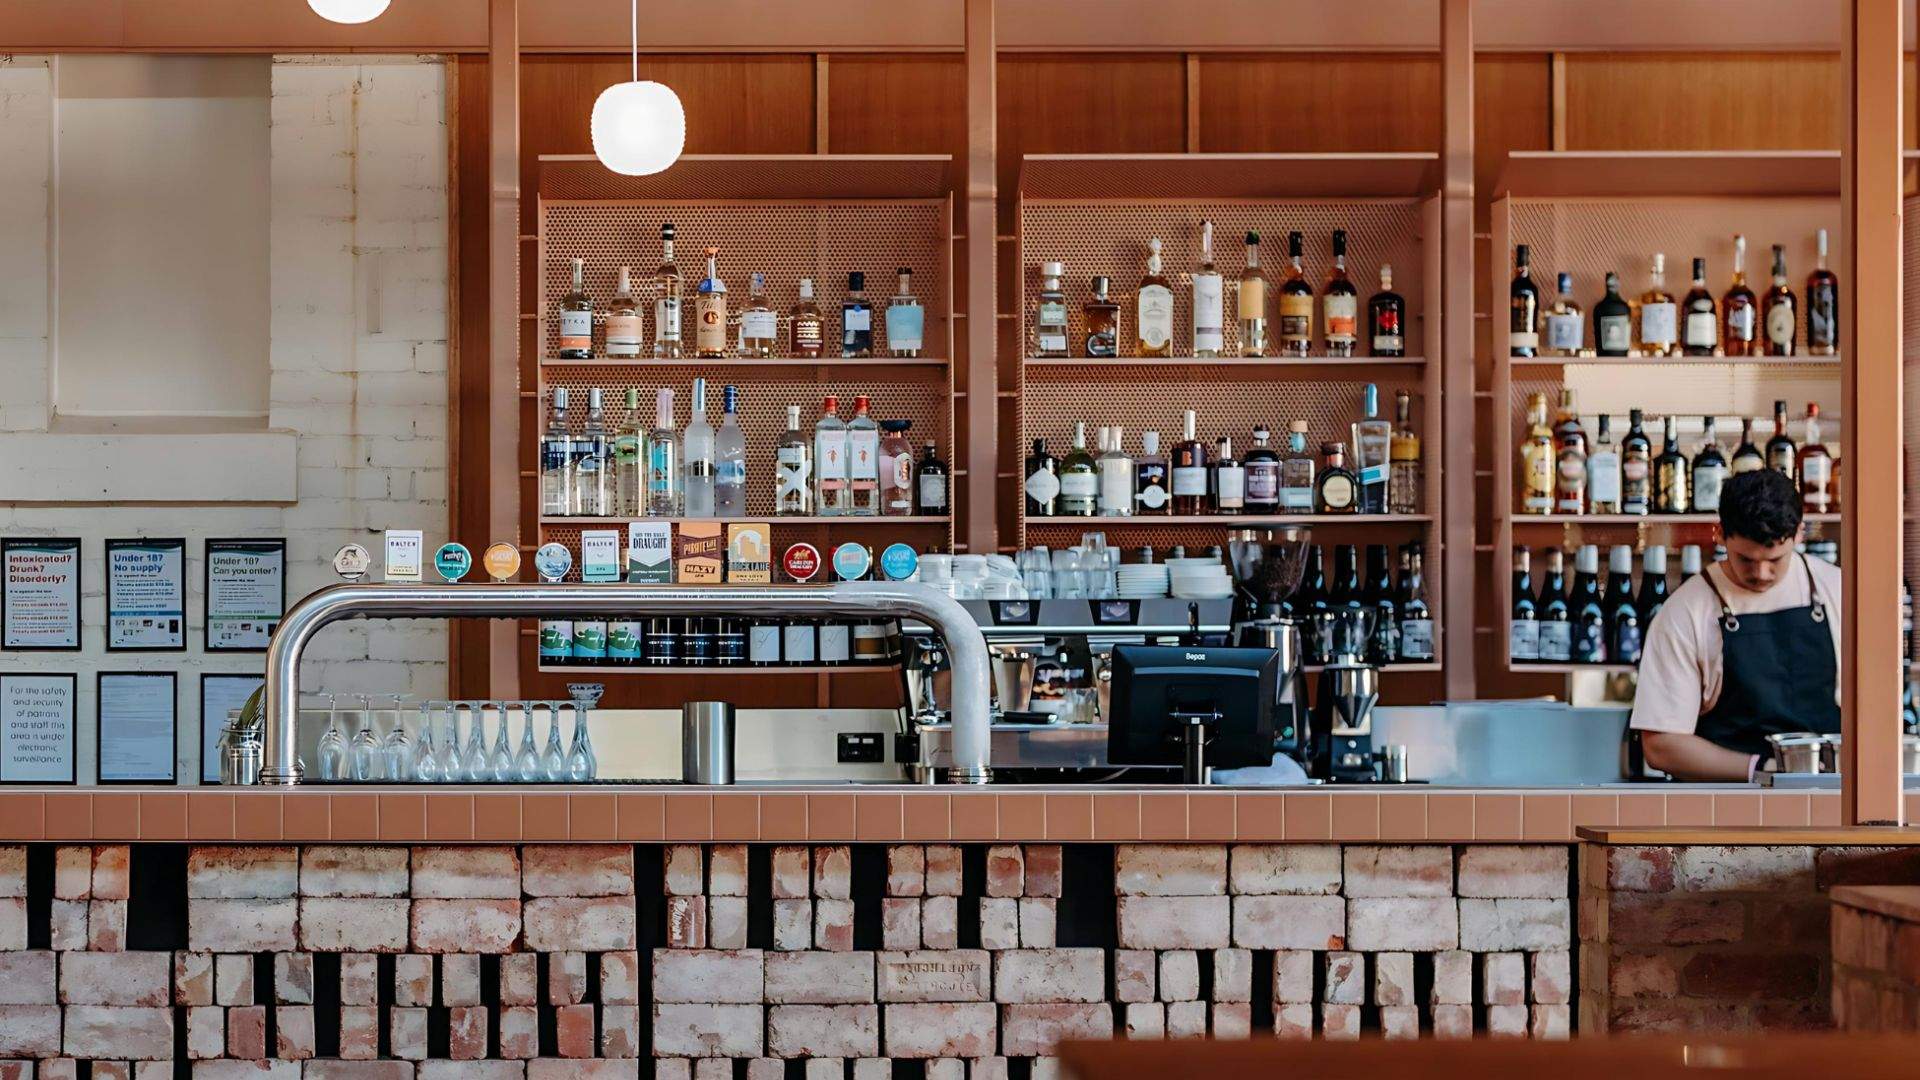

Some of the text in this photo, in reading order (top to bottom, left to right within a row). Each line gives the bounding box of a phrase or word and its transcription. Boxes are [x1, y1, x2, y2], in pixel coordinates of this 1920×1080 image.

[633, 537, 667, 549] DRAUGHT
[9, 555, 72, 563] Intoxicated?
[114, 554, 163, 562] Under 18?
[213, 557, 241, 565] Under
[9, 565, 45, 573] Drunk?
[114, 564, 163, 573] No supply
[213, 567, 277, 576] Can you enter?
[9, 575, 67, 584] Disorderly?
[10, 686, 67, 696] For the safety
[13, 698, 63, 707] and security
[30, 721, 48, 729] staff
[40, 732, 65, 740] under
[17, 743, 57, 752] electronic
[13, 755, 62, 763] surveillance
